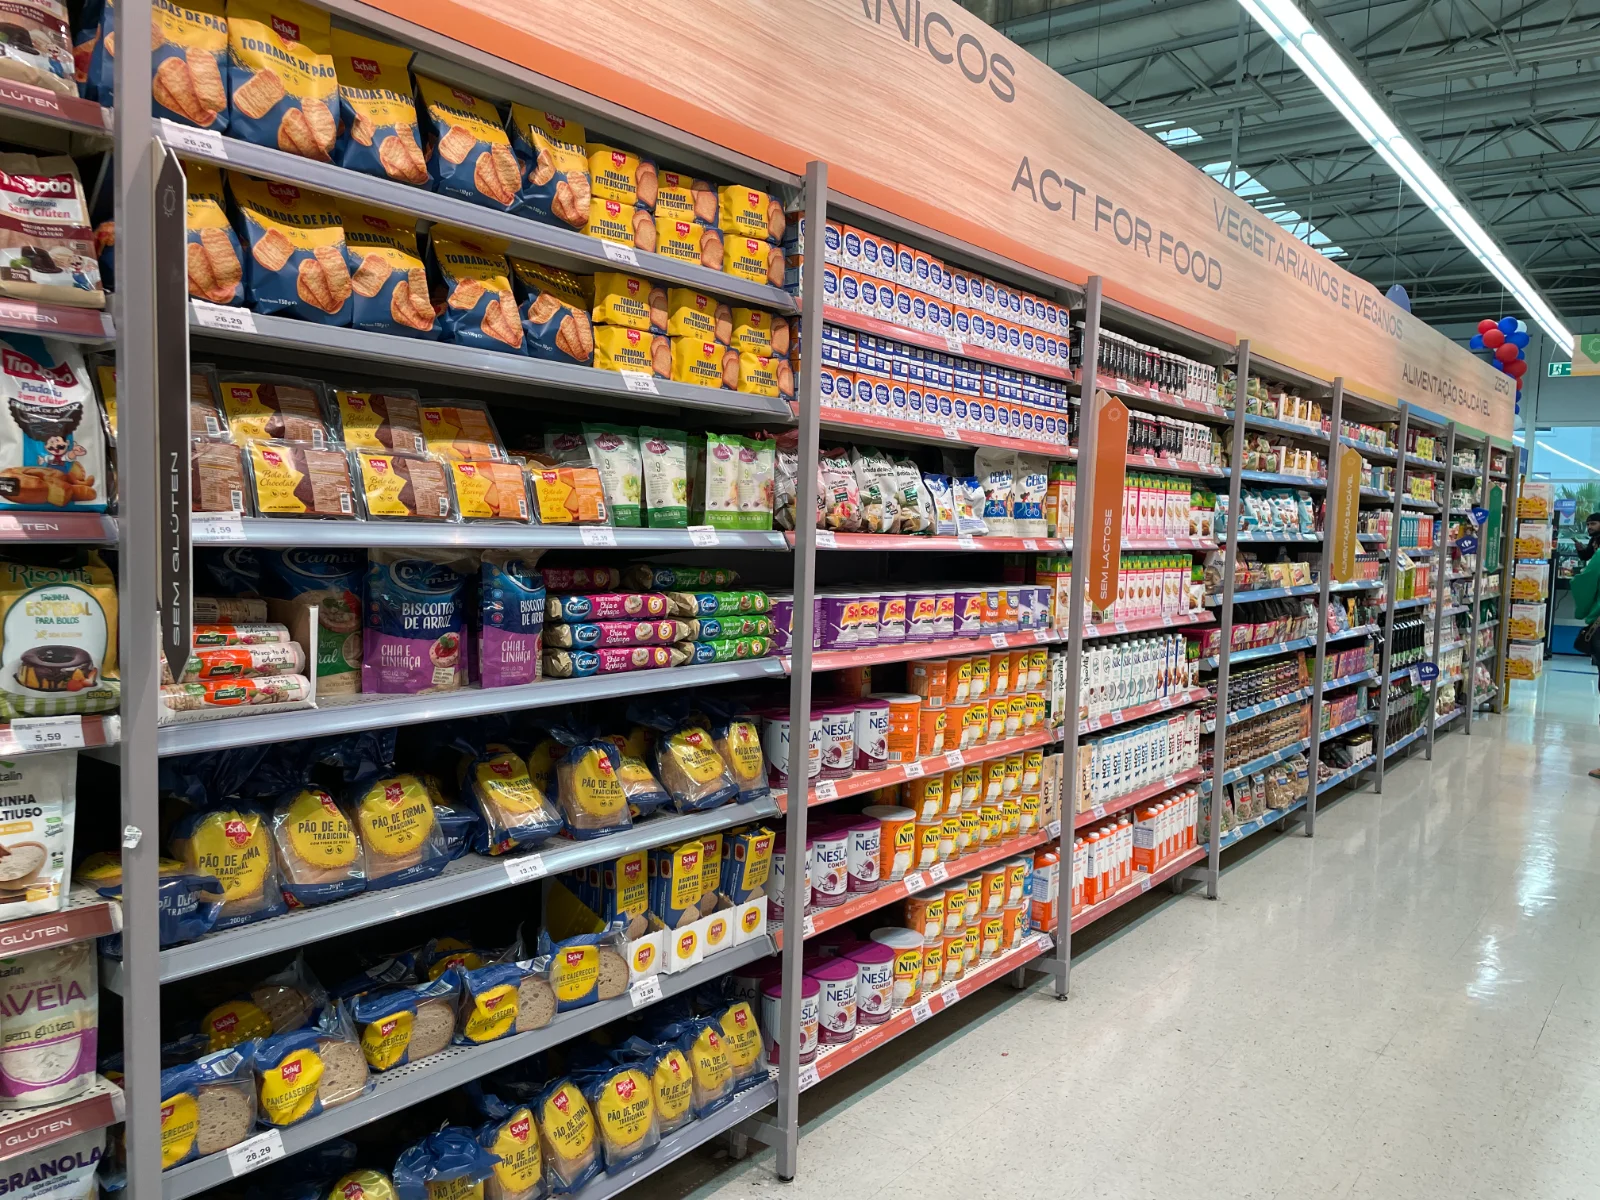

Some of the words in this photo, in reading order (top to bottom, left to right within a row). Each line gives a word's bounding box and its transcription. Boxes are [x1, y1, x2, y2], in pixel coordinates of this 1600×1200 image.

[186, 9, 200, 23] DE
[204, 11, 228, 34] PÃO
[241, 37, 296, 66] TORRADAS
[299, 60, 310, 74] DE
[312, 63, 335, 78] PÃO
[354, 60, 377, 73] Schär
[385, 90, 397, 101] DE
[434, 100, 478, 123] TORRADAS
[604, 170, 629, 183] TORRADAS
[595, 176, 608, 186] FETTE
[609, 179, 636, 193] BISCOTTATE
[8, 203, 29, 215] Sem
[33, 204, 70, 218] Glúten
[248, 201, 300, 224] TORRADAS
[303, 214, 318, 225] DE
[320, 212, 342, 225] PÃO
[600, 219, 626, 231] TORRADAS
[1011, 156, 1086, 222] ACT
[1094, 194, 1152, 259] FOR
[1159, 230, 1222, 291] FOOD
[591, 226, 605, 237] FETTE
[606, 229, 634, 241] BISCOTTATE
[669, 240, 694, 251] TORRADAS
[661, 246, 674, 257] FETTE
[675, 248, 700, 260] BISCOTTATE
[445, 254, 491, 267] TORRADAS
[733, 262, 744, 271] FETTE
[1214, 197, 1339, 302] VEGETARIANOS
[1341, 283, 1350, 310] E
[1354, 290, 1403, 340] VEGANOS
[621, 348, 645, 358] TORRADAS
[5, 355, 32, 374] Tio
[614, 354, 626, 364] FETTE
[627, 356, 652, 367] BISCOTTATE
[1402, 363, 1458, 405] ALIMENTAÇÃO
[1458, 388, 1490, 416] SAUDÁVEL
[1495, 375, 1509, 396] ZERO
[262, 470, 281, 479] Bolo
[656, 462, 661, 473] 9
[260, 477, 296, 487] Chocolate
[170, 452, 180, 573] GLÚTEN
[1102, 509, 1113, 569] LACTOSE
[25, 601, 93, 617] ESPECIAL
[172, 581, 181, 646] SEM
[402, 602, 454, 615] BISCOITOS
[568, 603, 589, 611] Camil
[404, 617, 419, 629] DE
[423, 615, 451, 629] ARROZ
[578, 630, 598, 638] Camil
[381, 645, 403, 656] CHIA
[405, 645, 410, 656] E
[501, 640, 521, 651] CHIA
[522, 640, 526, 650] E
[381, 656, 421, 670] LINHAÇA
[501, 650, 530, 663] LINHAÇA
[582, 778, 596, 788] PÃO
[598, 779, 608, 789] DE
[372, 817, 389, 830] PÃO
[391, 814, 401, 825] DE
[402, 804, 427, 820] FORMA
[298, 820, 317, 833] PÃO
[321, 820, 334, 832] DE
[199, 853, 219, 868] PÃO
[225, 855, 238, 866] DE
[678, 874, 699, 885] BISCOITOS
[624, 883, 644, 894] BISCOITOS
[0, 924, 68, 946] GLÚTEN
[0, 980, 87, 1018] AVEIA
[4, 1029, 31, 1042] sem
[35, 1020, 76, 1039] glúten
[701, 1059, 711, 1068] PÃO
[713, 1057, 720, 1067] DE
[266, 1093, 284, 1105] PANE
[607, 1110, 621, 1123] PÃO
[623, 1106, 631, 1117] DE
[554, 1127, 566, 1139] PÃO
[567, 1119, 575, 1129] DE
[574, 1105, 588, 1125] FORMA
[5, 1117, 73, 1146] GLÚTEN
[502, 1153, 514, 1168] PÃO
[517, 1151, 526, 1162] DE
[0, 1146, 102, 1196] GRANOLA
